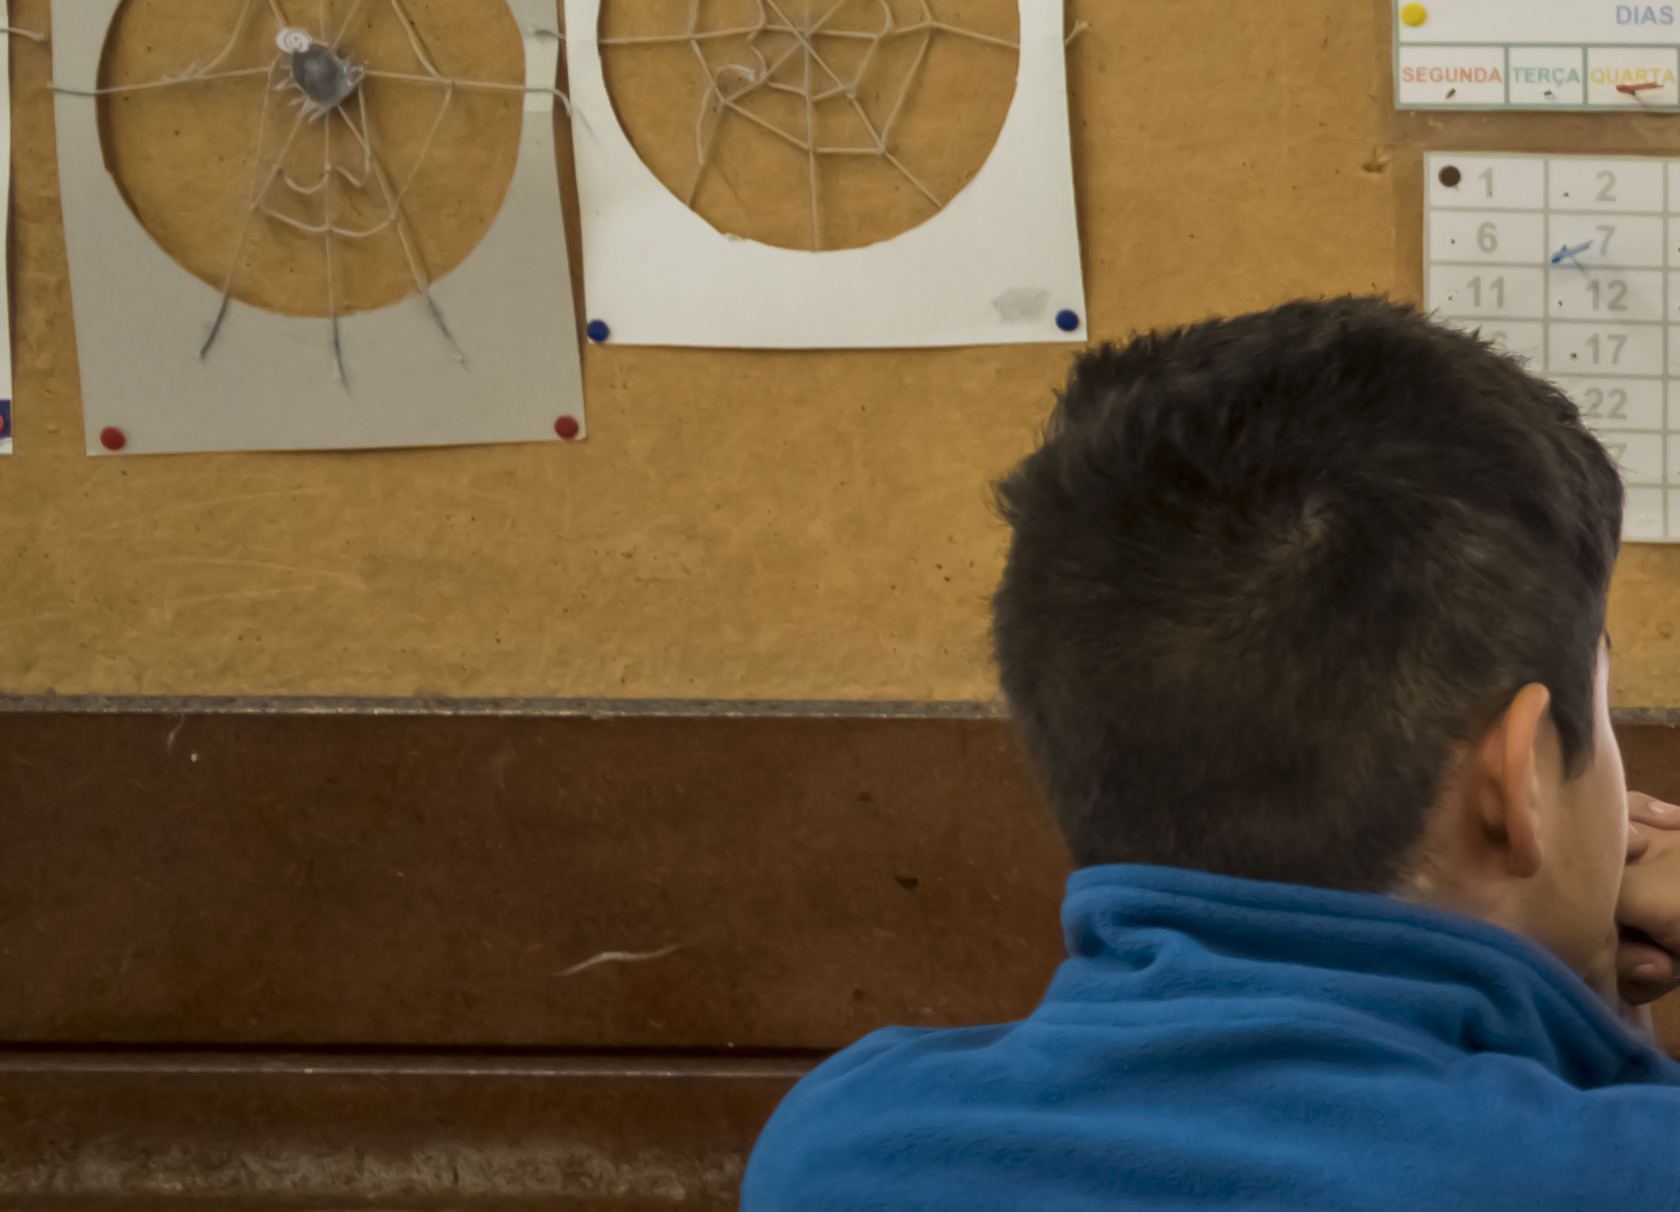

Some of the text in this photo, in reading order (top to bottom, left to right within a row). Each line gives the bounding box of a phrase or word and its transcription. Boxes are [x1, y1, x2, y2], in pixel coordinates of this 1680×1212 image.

[1615, 5, 1677, 26] DIAS
[1402, 67, 1501, 84] SEGUNDA
[1513, 67, 1580, 88] TERÇA
[1591, 68, 1676, 85] QUARTA
[1478, 167, 1493, 198] 1
[1596, 170, 1616, 201] 2
[1477, 222, 1497, 253] 6
[1596, 225, 1616, 256] 7
[1466, 276, 1505, 308] 11
[1586, 279, 1628, 312] 12
[1585, 333, 1627, 365] 17
[1584, 388, 1627, 420] 22
